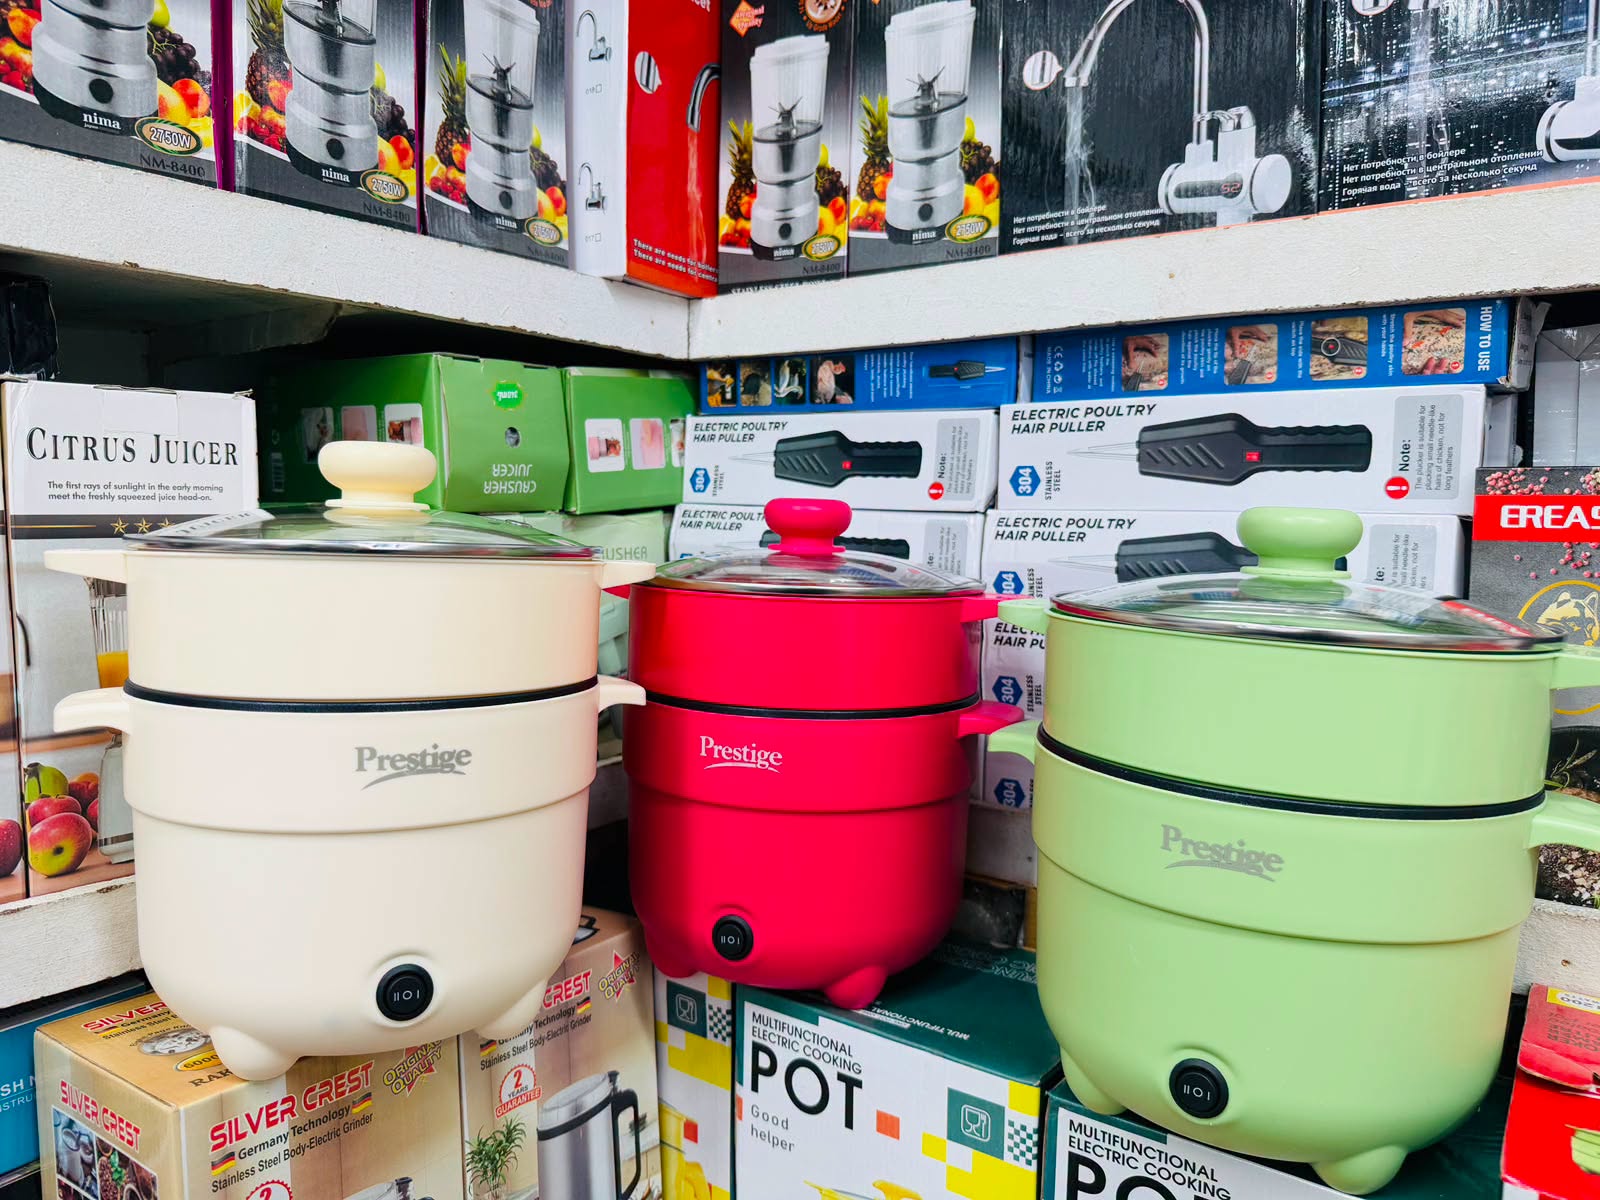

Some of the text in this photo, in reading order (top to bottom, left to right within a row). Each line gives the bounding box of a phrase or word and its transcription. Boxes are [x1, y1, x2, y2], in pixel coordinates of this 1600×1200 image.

[82, 112, 121, 130] nima
[150, 127, 192, 149] 2750W
[140, 153, 206, 178] NM-8400
[1343, 148, 1466, 172] Нет потребности бойлере
[1343, 150, 1544, 184] Нет потребности центральном отоплении
[321, 168, 350, 182] nima
[372, 178, 402, 197] 2750W
[1342, 163, 1538, 197] Горячая вода всего за несколько секунд
[363, 201, 410, 222] NM-8400
[495, 216, 518, 229] nima
[912, 230, 936, 242] nima
[956, 222, 984, 237] 2750W
[634, 238, 652, 252] There
[655, 248, 666, 256] are
[634, 248, 652, 262] There
[655, 258, 666, 266] are
[774, 248, 794, 258] nima
[945, 244, 991, 259] NM-8400
[1477, 306, 1493, 372] HOW TO USE
[1011, 404, 1157, 422] ELECTRIC POULTRY
[693, 433, 755, 444] HAIR PULLER
[694, 421, 788, 432] ELECTRIC POULTRY
[1011, 420, 1106, 434] HAIR PULLER
[1417, 416, 1425, 442] suitable
[1437, 423, 1445, 434] not
[26, 426, 239, 466] CITRUS JUICER
[1398, 439, 1412, 472] Note:
[492, 464, 533, 478] JUICER
[938, 452, 946, 479] Note:
[1416, 451, 1424, 476] plucker
[1425, 462, 1434, 491] plucking
[1444, 446, 1453, 491] long feathers
[48, 481, 224, 493] The first rays of sunlight in the early morning
[484, 480, 536, 494] CRUSHER
[694, 470, 706, 491] 304
[1018, 468, 1033, 494] 304
[1045, 461, 1053, 500] STAINLESS
[48, 492, 212, 502] meet the freshly squeezed juice head-on.
[680, 520, 742, 531] HAIR PULLER
[682, 510, 728, 520] ELECTRIC
[996, 518, 1137, 530] ELECTRIC POULTRY
[994, 530, 1087, 542] HAIR PULLER
[994, 635, 1027, 648] HAIR
[1002, 678, 1014, 704] 304
[1026, 674, 1034, 712] STAINLESS
[355, 743, 472, 776] Prestige
[700, 735, 783, 770] Prestige
[1003, 781, 1016, 808] 304
[1160, 824, 1285, 876] Prestige
[542, 969, 592, 1010] CREST
[82, 1001, 168, 1032] SILVER
[121, 1010, 171, 1028] Germany
[534, 1004, 576, 1030] Technology
[872, 1006, 970, 1040] MULTIFUNCTIONAL
[103, 1024, 148, 1040] Stainless
[480, 1050, 511, 1072] Stainless
[512, 1040, 528, 1056] Steel
[530, 1024, 569, 1050] Body-Electric
[570, 1014, 592, 1030] Grinder
[752, 1011, 854, 1058] MULTIFUNCTIONAL
[751, 1026, 862, 1074] ELECTRIC COOKING
[391, 1046, 442, 1094] QUALITY
[513, 1070, 522, 1090] 2
[508, 1085, 529, 1099] YEARS
[750, 1040, 862, 1130] POT
[209, 1060, 375, 1153] SILVER CREST
[496, 1087, 542, 1116] GUARANTEE
[60, 1080, 141, 1151] SILVER CREST
[750, 1104, 790, 1130] Good
[238, 1104, 350, 1160] Germany Technology
[750, 1124, 795, 1152] helper
[212, 1112, 374, 1193] Stainless Steel Body-Electric Grinder
[1069, 1120, 1218, 1183] MULTIFUNCTIONAL
[1068, 1135, 1139, 1170] ELECTRIC
[1144, 1162, 1232, 1200] COOKING
